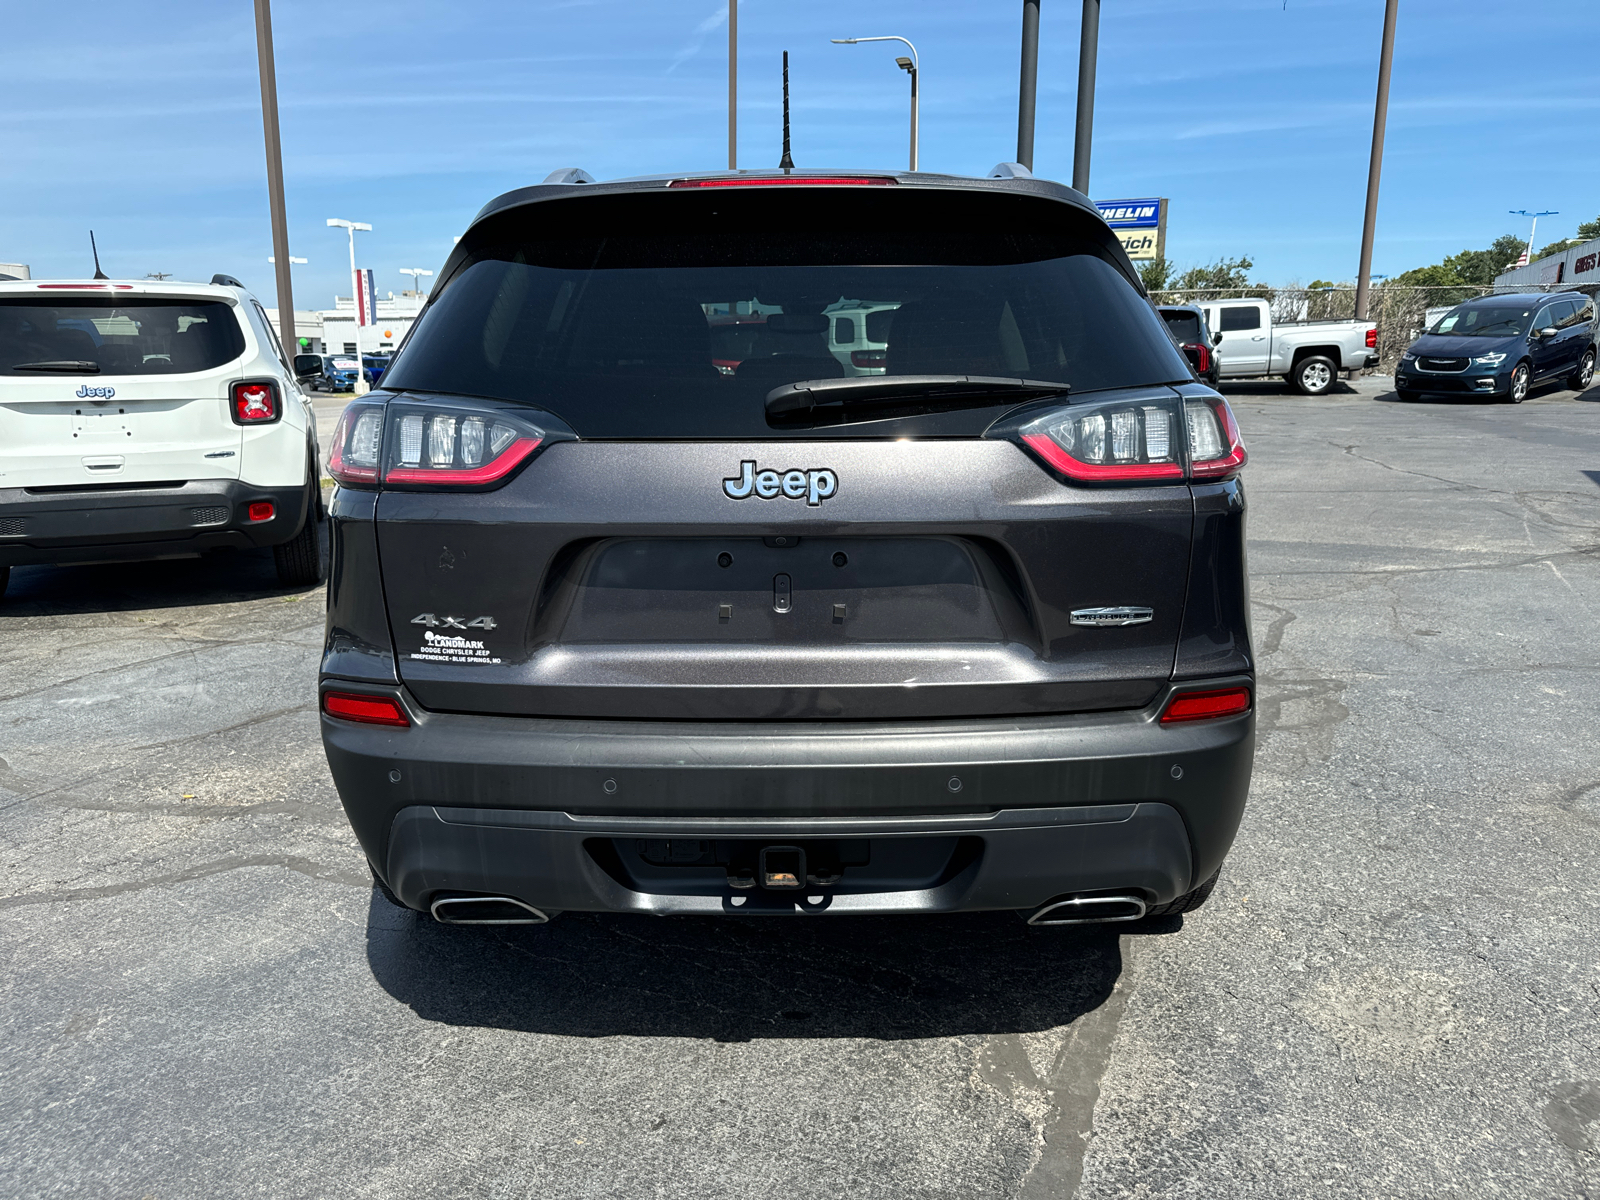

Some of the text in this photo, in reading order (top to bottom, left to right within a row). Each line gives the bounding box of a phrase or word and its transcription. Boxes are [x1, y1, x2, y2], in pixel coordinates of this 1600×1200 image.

[76, 384, 115, 399] Jeep
[722, 460, 839, 506] Jeep
[434, 640, 484, 649] LANDMARK
[442, 648, 474, 656] CHRYSLER
[411, 653, 449, 661] INDEPENDENCE
